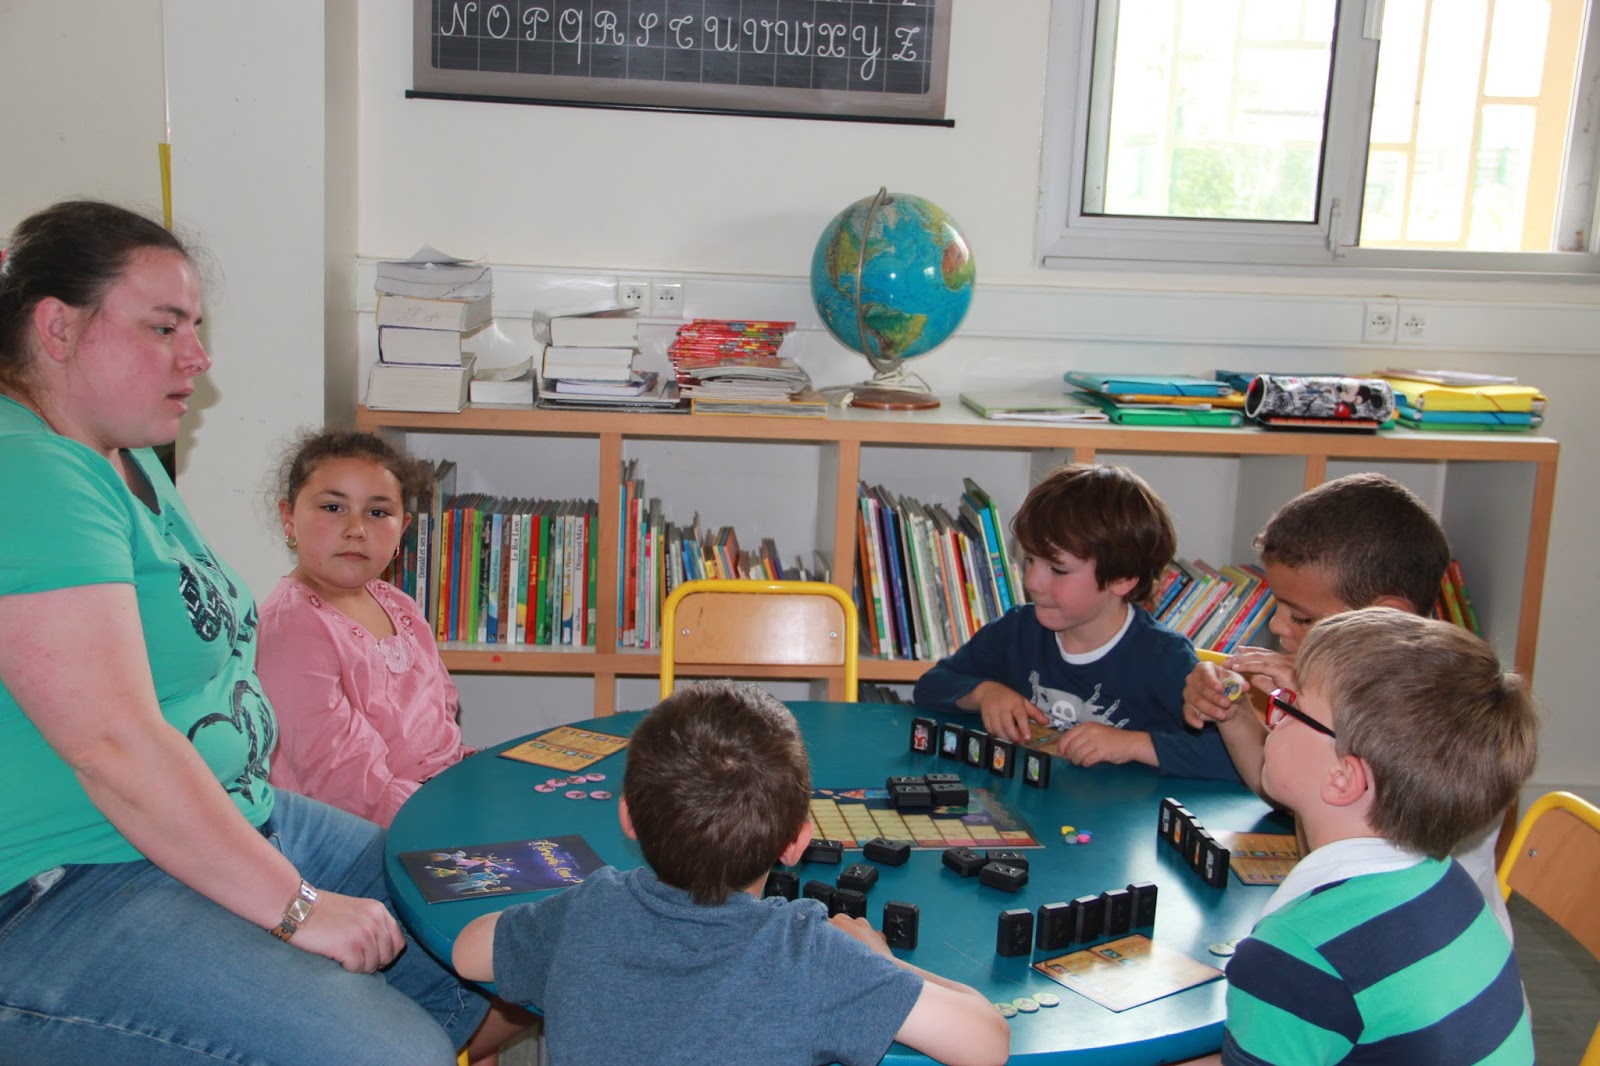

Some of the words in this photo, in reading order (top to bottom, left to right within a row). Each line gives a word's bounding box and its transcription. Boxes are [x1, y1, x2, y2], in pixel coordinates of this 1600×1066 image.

[440, 2, 477, 37] N
[487, 4, 510, 39] O
[522, 7, 549, 41] P
[594, 10, 625, 45] R
[636, 12, 659, 47] S
[669, 15, 693, 48] T
[704, 16, 738, 52] U
[743, 18, 774, 54] V
[774, 20, 815, 56] W
[817, 23, 846, 58] X
[892, 26, 920, 62] Z
[512, 551, 518, 560] Le
